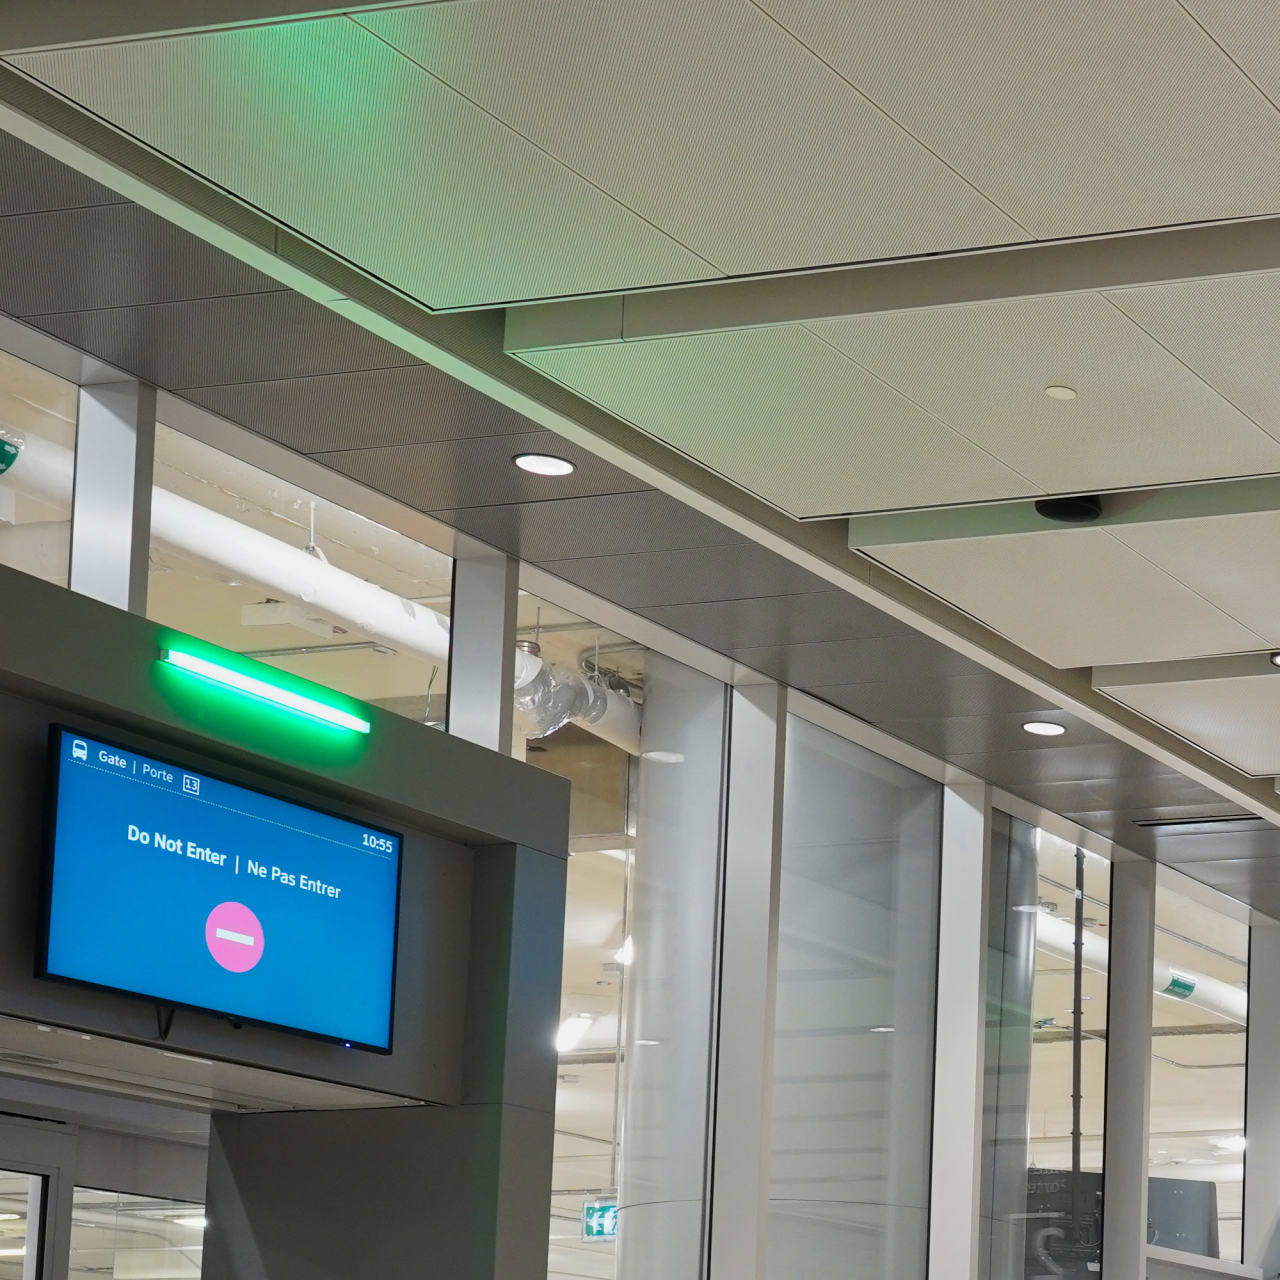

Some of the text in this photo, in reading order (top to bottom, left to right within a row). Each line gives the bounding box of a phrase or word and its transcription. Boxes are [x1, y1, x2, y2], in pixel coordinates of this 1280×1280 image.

[99, 749, 126, 770] Gate
[142, 764, 174, 784] Porte
[186, 778, 198, 791] 13
[127, 824, 150, 846] Do
[154, 832, 183, 856] Not
[186, 842, 226, 867] Enter
[248, 860, 268, 879] Ne
[272, 866, 296, 887] Pas
[300, 874, 342, 900] Entrer
[362, 832, 393, 854] 10:55
